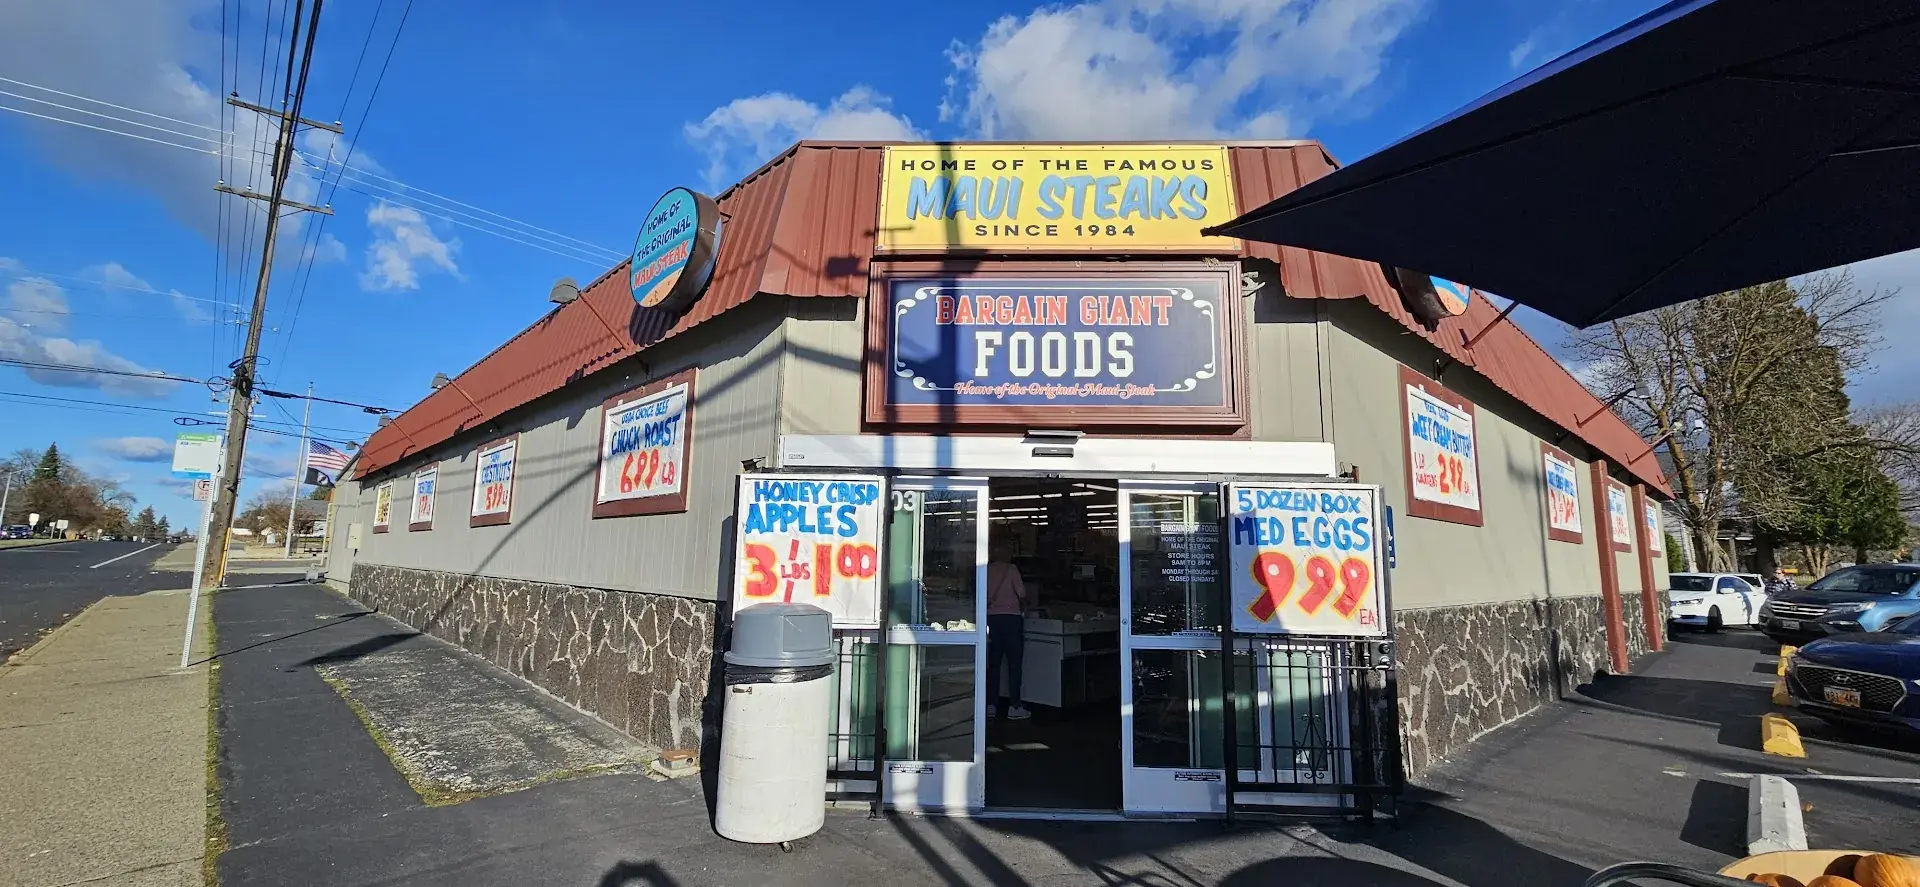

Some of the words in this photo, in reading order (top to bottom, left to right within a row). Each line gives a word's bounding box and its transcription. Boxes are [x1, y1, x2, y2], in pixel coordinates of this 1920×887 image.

[901, 159, 976, 171] HOME
[992, 159, 1025, 171] OF
[1040, 160, 1088, 171] THE
[1104, 159, 1214, 171] FAMOUS
[906, 175, 1024, 221] MAUI
[1036, 174, 1208, 222] STEAKS
[647, 209, 669, 235] HOME
[669, 200, 681, 218] OF
[975, 224, 1058, 237] SINCE
[1074, 224, 1135, 237] 1984
[637, 242, 650, 262] THE
[651, 215, 691, 251] ORIGINAL
[632, 261, 655, 290] MAUI
[654, 240, 690, 277] STEAK
[936, 295, 1068, 325] BARGAIN
[1079, 295, 1173, 325] GIANT
[975, 331, 1134, 378] FOODS
[954, 380, 994, 396] Home
[992, 383, 1010, 399] of
[1008, 383, 1027, 396] the
[1029, 383, 1079, 400] Original
[1079, 383, 1120, 397] Maui
[1120, 383, 1156, 399] Steak
[635, 406, 654, 421] CHOICE
[655, 399, 671, 416] BEEF
[611, 425, 641, 455] CHUCK
[644, 413, 682, 448] ROAST
[1432, 420, 1451, 450] CREAM
[620, 448, 660, 493] 699
[661, 460, 676, 486] LB
[1437, 451, 1463, 494] 299
[754, 481, 825, 505] HONEY
[826, 482, 879, 506] CRISP
[1237, 489, 1253, 512] 5
[1256, 490, 1317, 512] DOZEN
[1321, 492, 1361, 514] BOX
[744, 503, 858, 538] APPLES
[1234, 516, 1285, 546] MED
[1292, 516, 1371, 551] EGGS
[745, 543, 778, 597] 3
[780, 562, 811, 580] LBS
[1249, 551, 1370, 622] 999
[1360, 608, 1377, 626] EA
